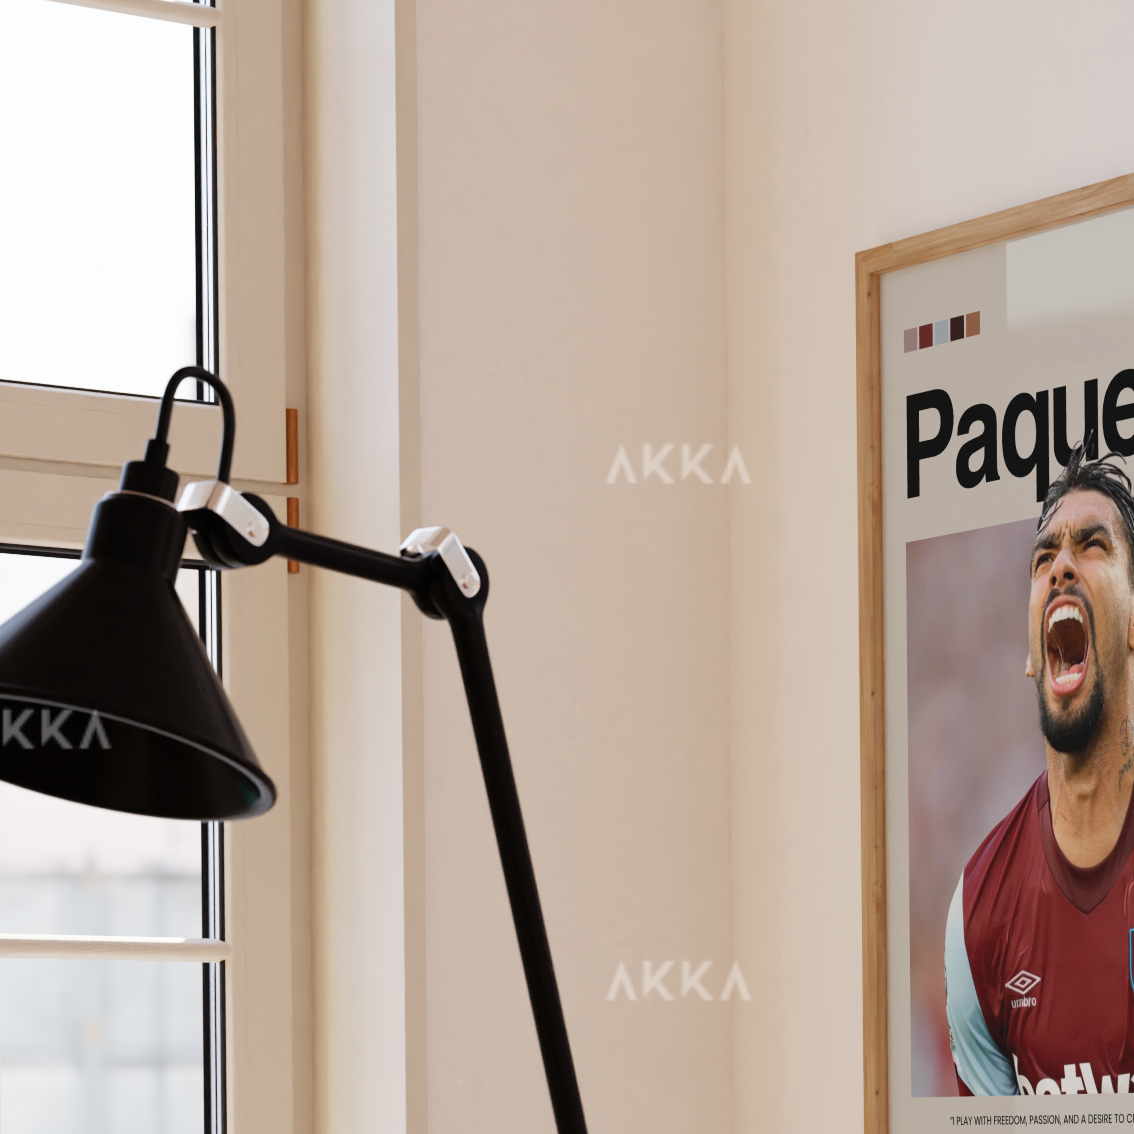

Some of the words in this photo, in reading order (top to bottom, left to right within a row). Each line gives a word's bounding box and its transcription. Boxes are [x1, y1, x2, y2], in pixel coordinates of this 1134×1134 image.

[1011, 996, 1037, 1009] umbro
[956, 1116, 973, 1126] PLAY
[974, 1115, 992, 1125] WITH
[993, 1115, 1028, 1127] FREEDOM,
[1029, 1114, 1062, 1126] PASSION,
[1063, 1114, 1080, 1125] AND
[1081, 1114, 1087, 1124] A
[1088, 1113, 1113, 1124] DESIRE
[1115, 1113, 1125, 1124] TO
